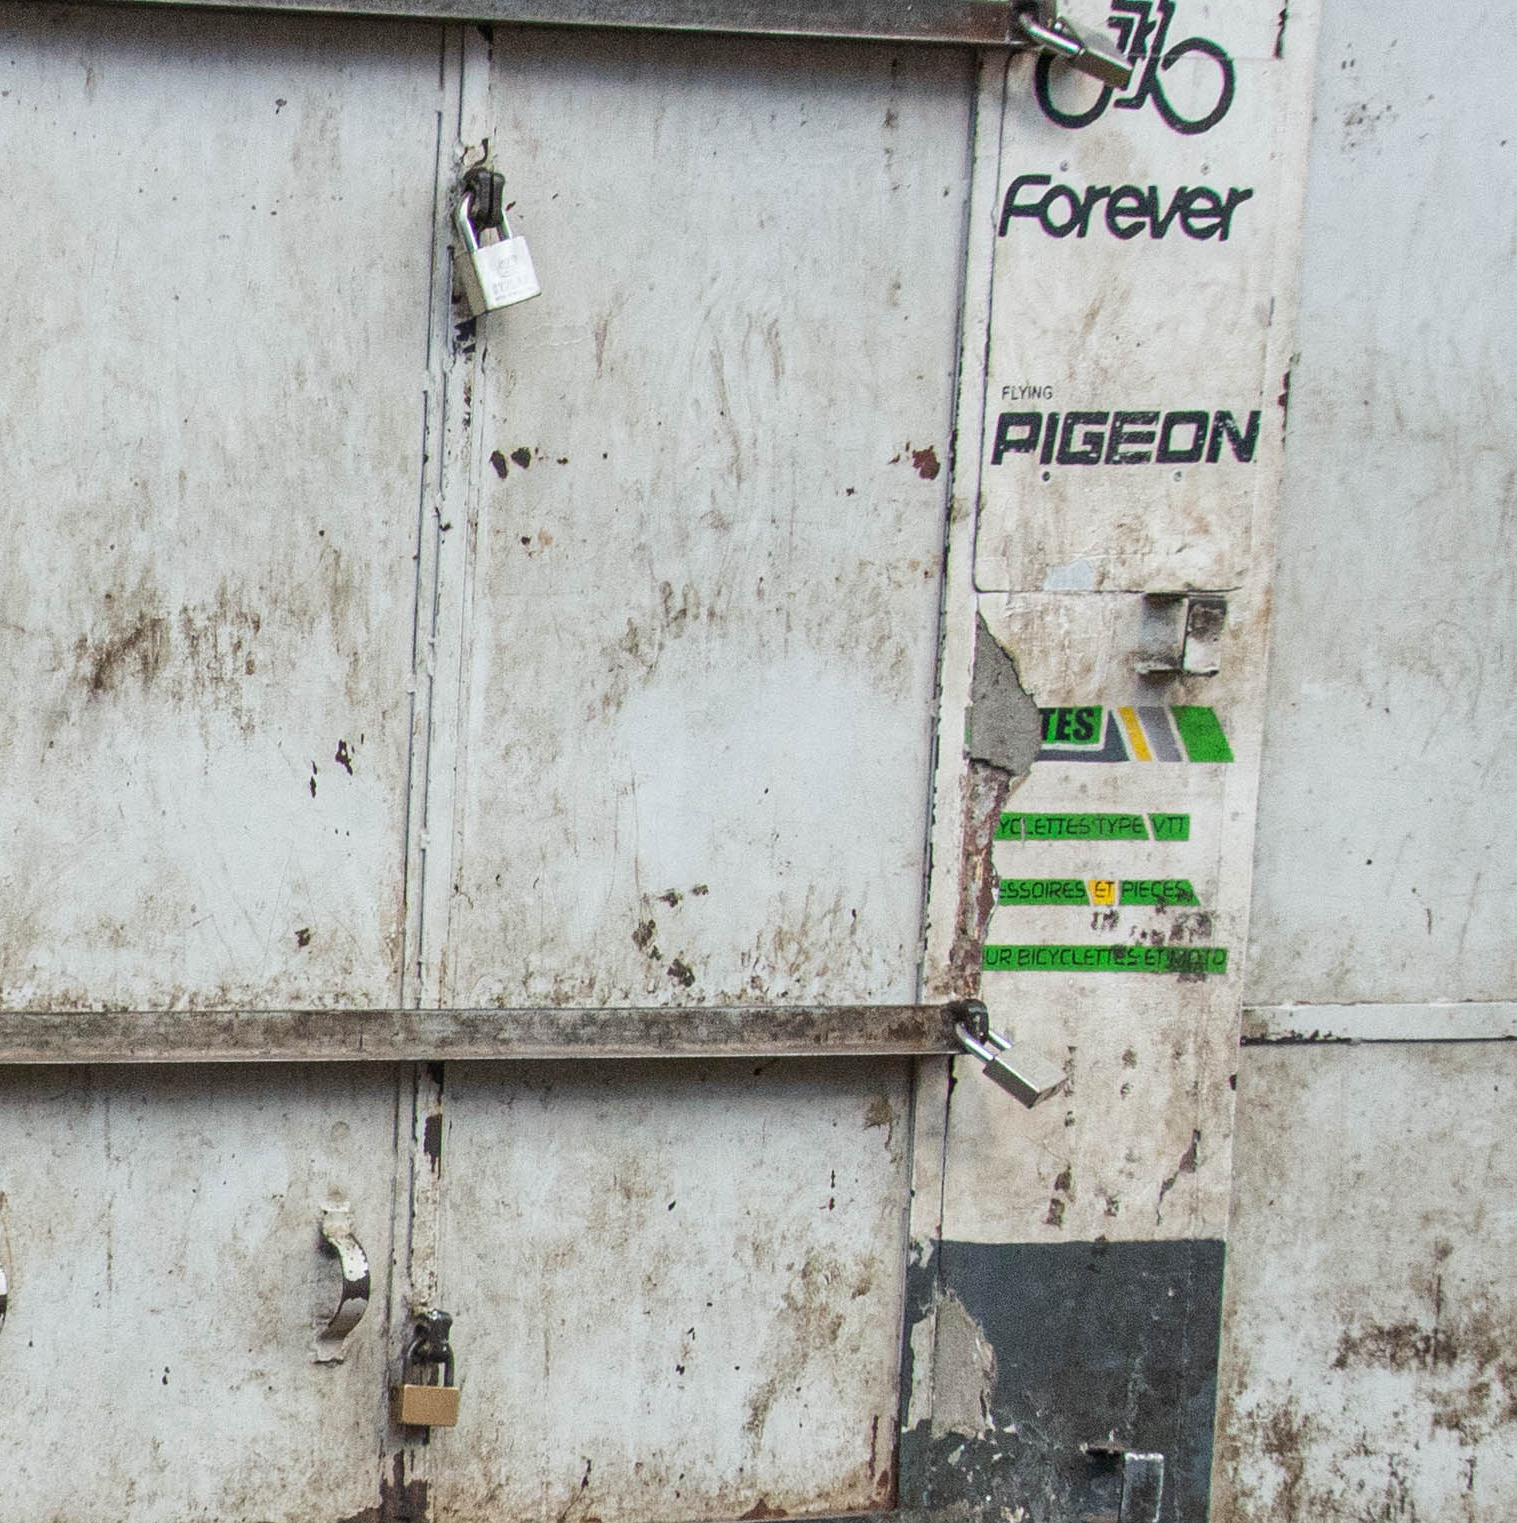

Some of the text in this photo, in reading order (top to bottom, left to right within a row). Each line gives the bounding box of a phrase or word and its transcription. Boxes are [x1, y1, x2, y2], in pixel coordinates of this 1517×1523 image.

[998, 174, 1254, 241] Forever
[1002, 385, 1053, 400] FLYING
[991, 410, 1262, 465] PIGEON
[1000, 816, 1184, 836] YCLETTES TYPE VTT
[1000, 880, 1183, 899] ESSOIRES ET PIECES
[986, 949, 1012, 966] UR
[1017, 948, 1138, 967] BICYCLETTES
[1144, 949, 1166, 967] ET
